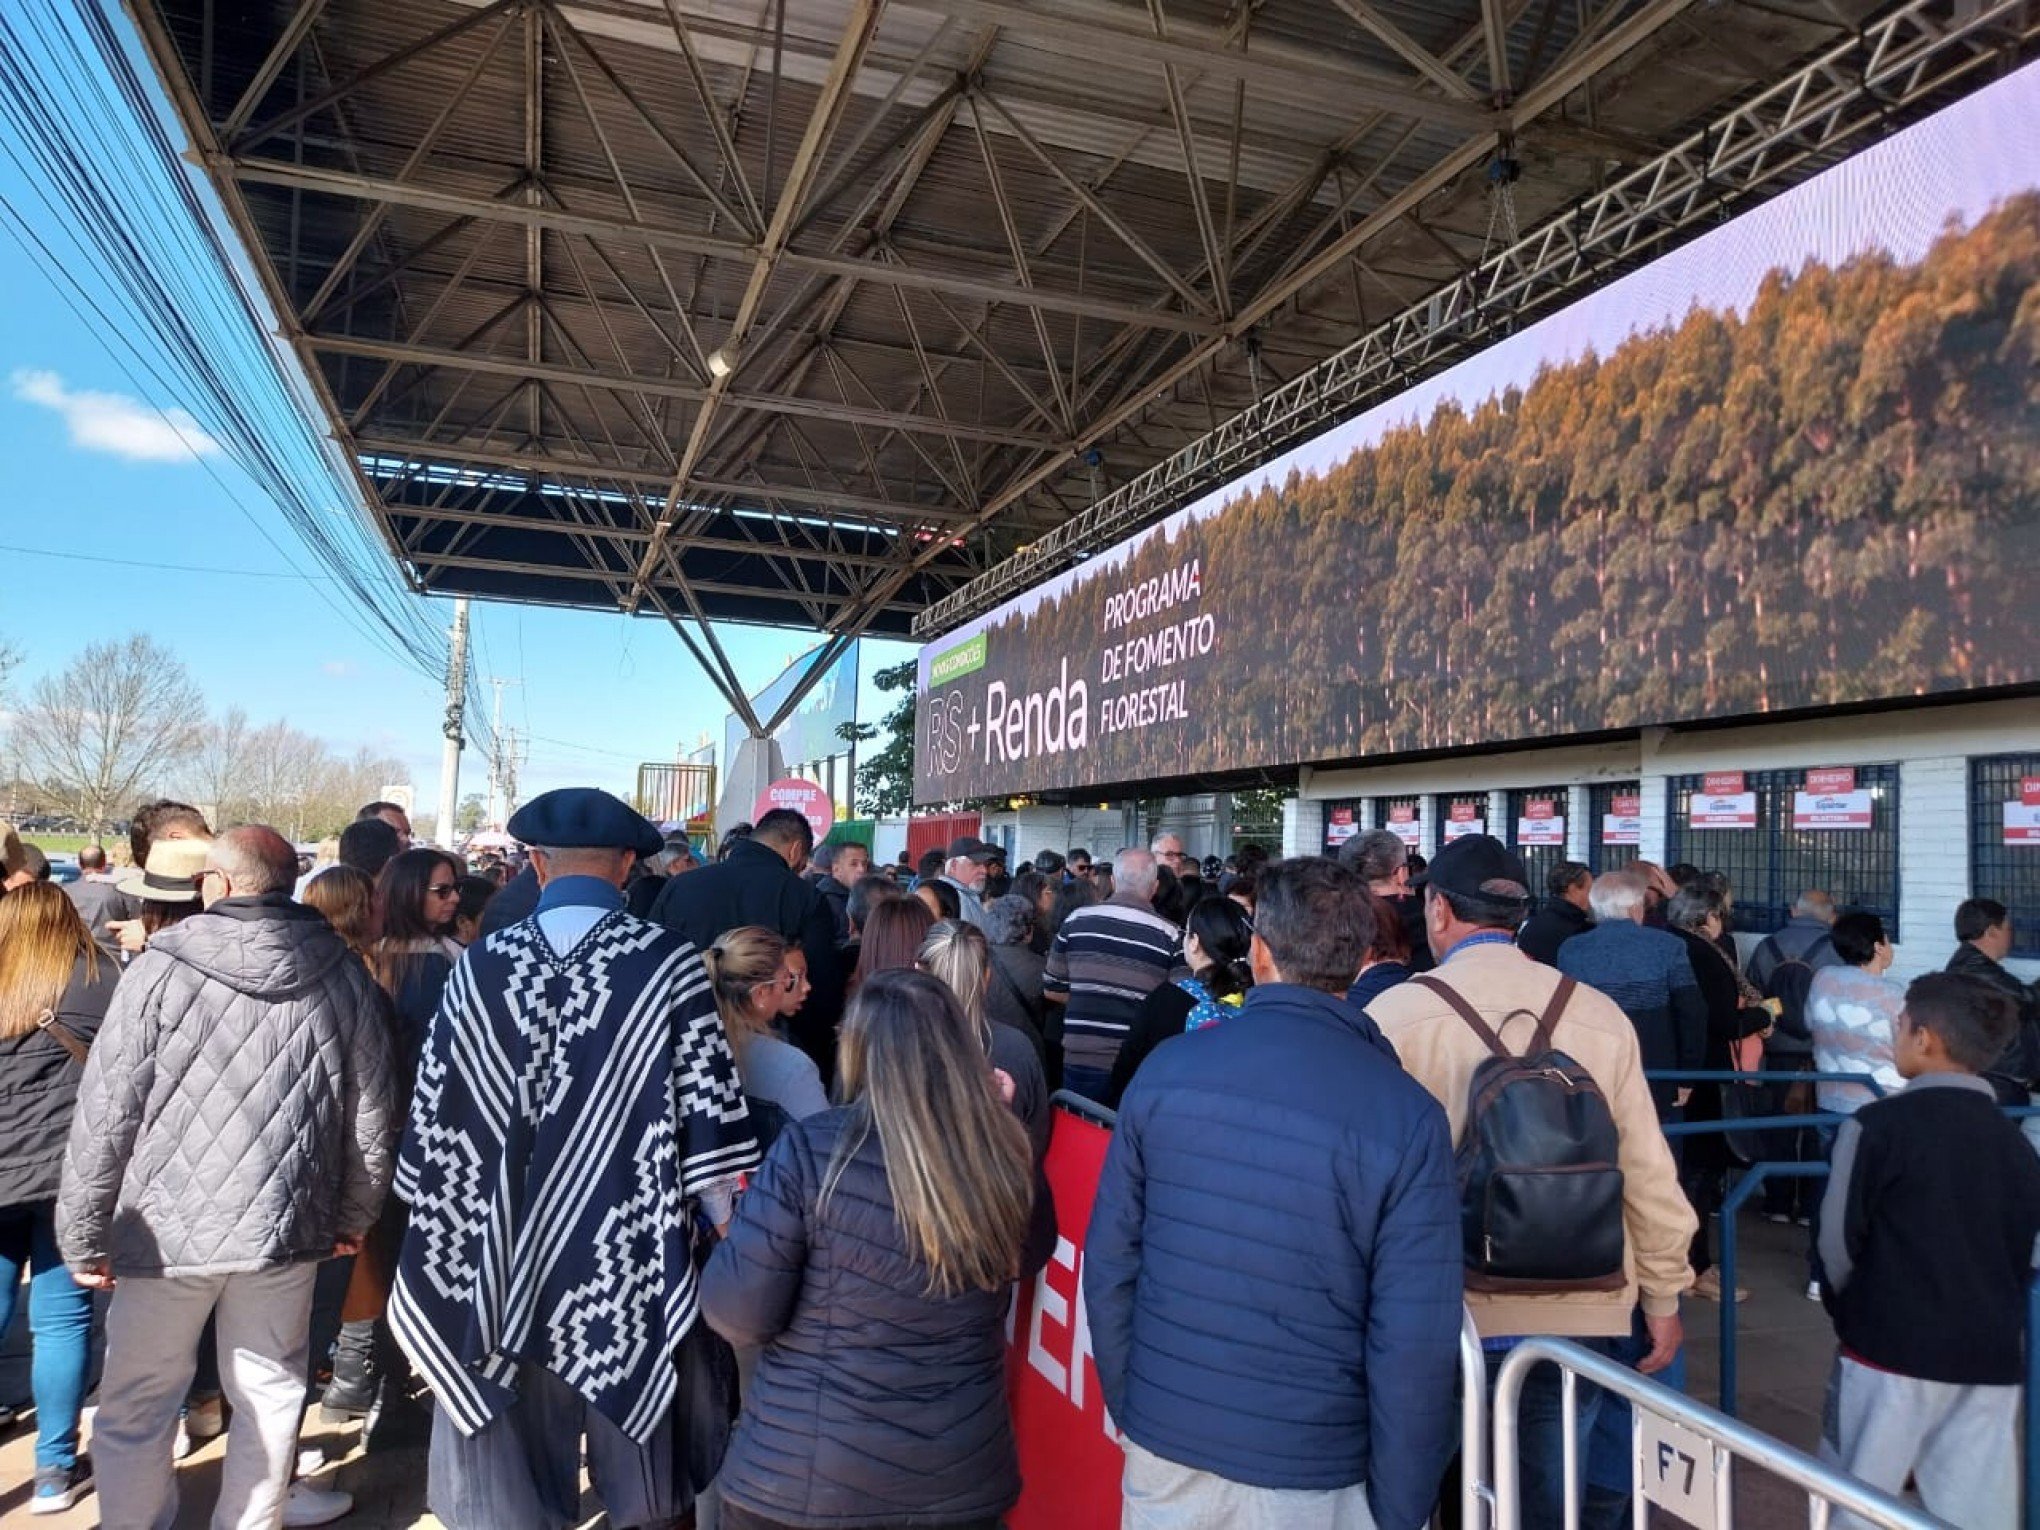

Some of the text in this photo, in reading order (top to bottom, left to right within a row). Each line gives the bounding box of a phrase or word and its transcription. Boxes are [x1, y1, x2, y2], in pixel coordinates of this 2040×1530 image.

[1104, 558, 1200, 632] PROGRAMA
[1102, 612, 1215, 684] DE FOMENTO
[985, 656, 1088, 765] Renda
[1101, 679, 1189, 734] FLORESTAL
[1657, 1440, 1696, 1496] F7
